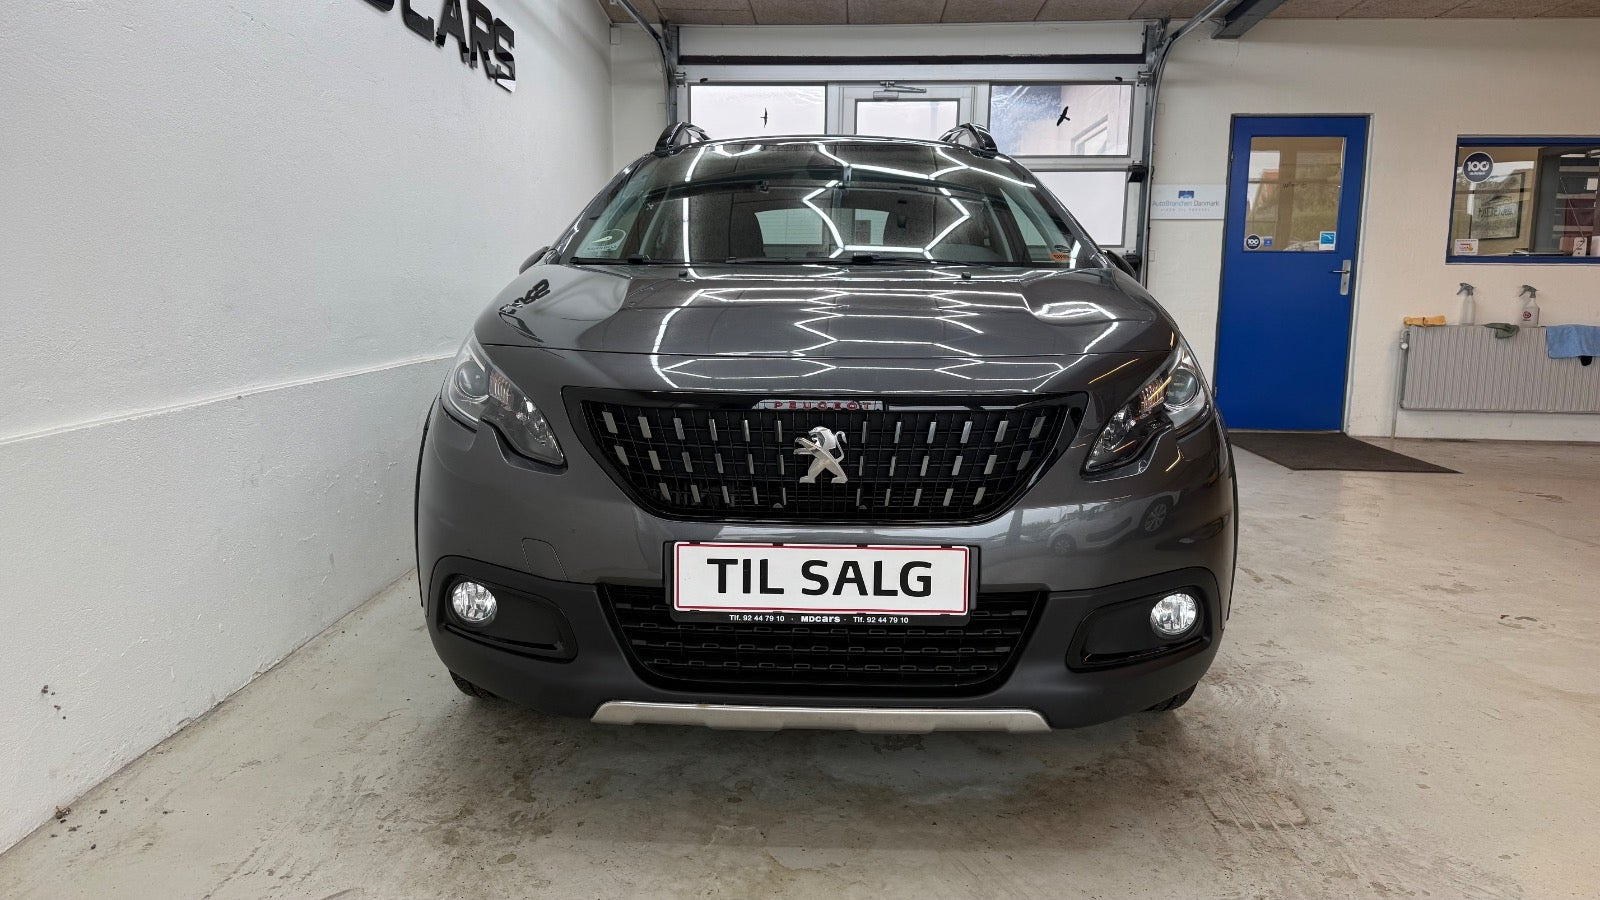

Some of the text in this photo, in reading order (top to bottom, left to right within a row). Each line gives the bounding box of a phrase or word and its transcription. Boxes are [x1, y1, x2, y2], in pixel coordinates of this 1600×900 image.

[1193, 200, 1219, 208] Danmark
[774, 401, 872, 411] PEUGEOT
[707, 558, 932, 598] TIL SALG
[743, 614, 752, 622] 92
[801, 615, 840, 623] MDcars
[877, 616, 887, 624] 44
